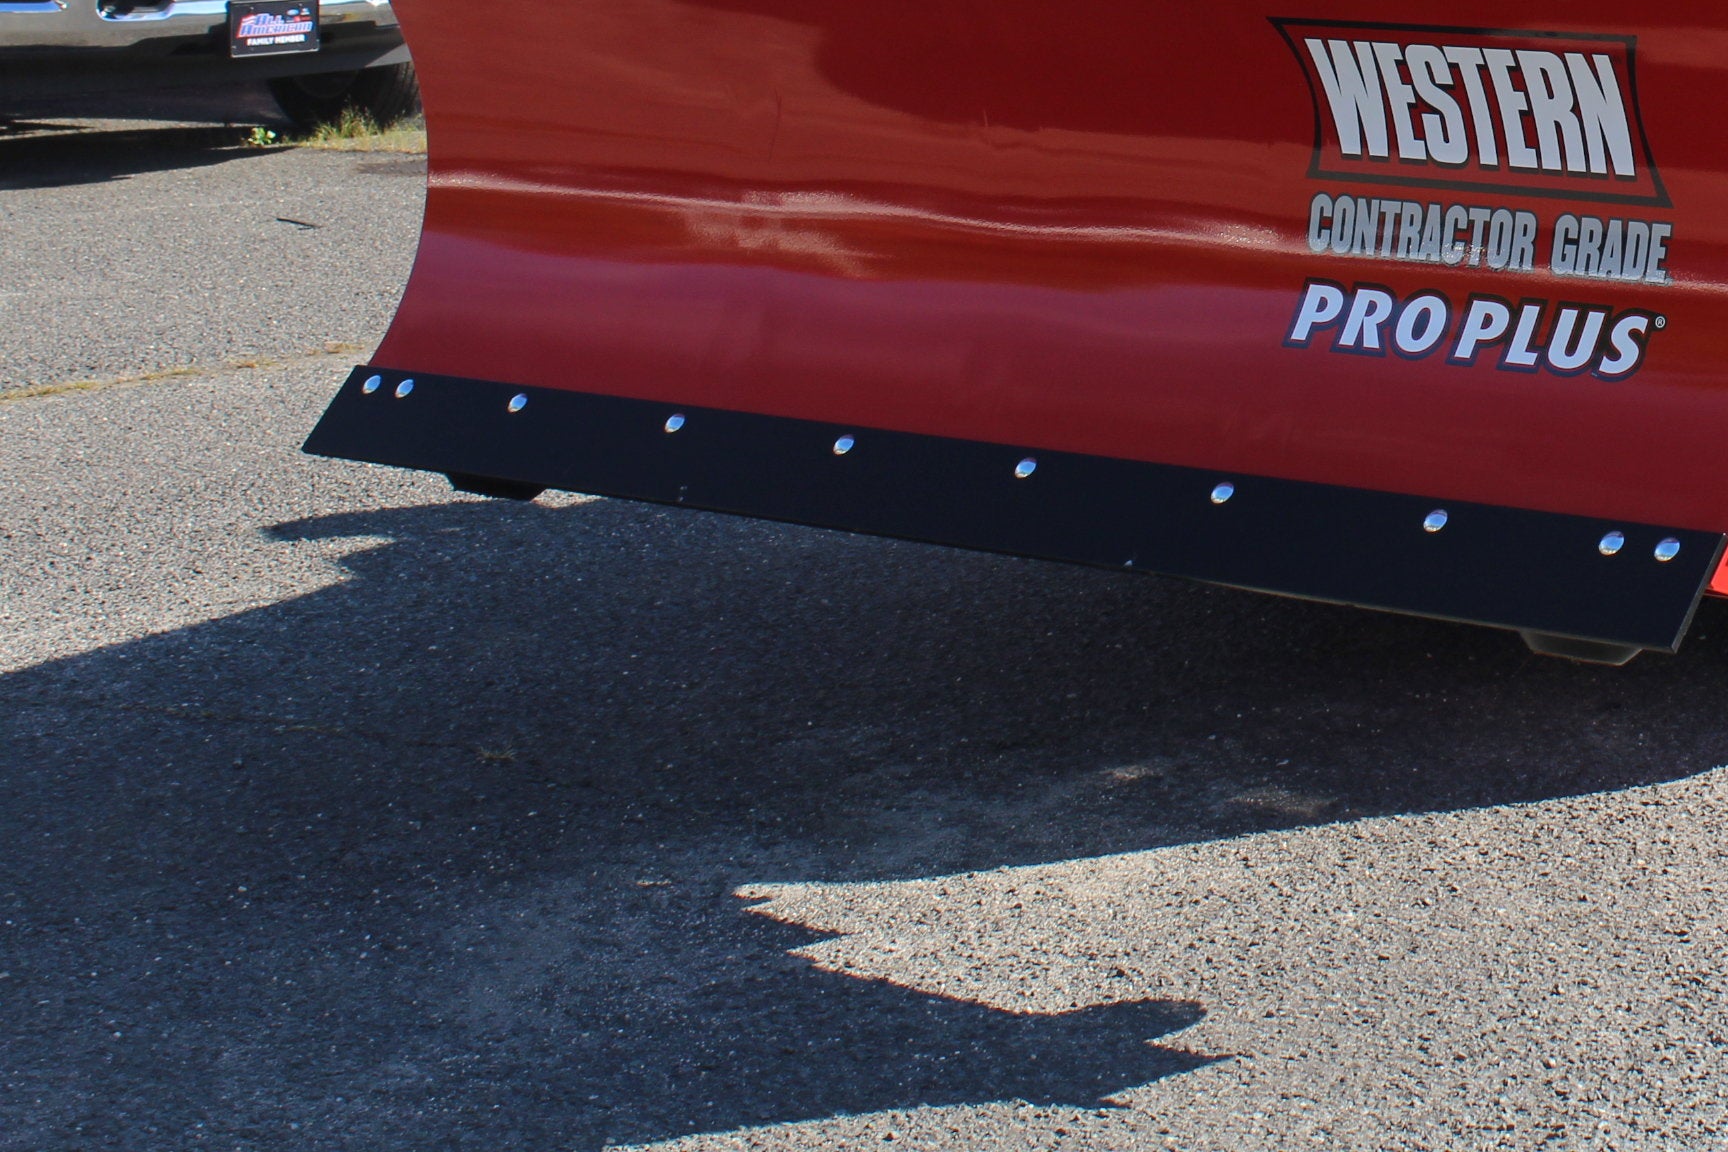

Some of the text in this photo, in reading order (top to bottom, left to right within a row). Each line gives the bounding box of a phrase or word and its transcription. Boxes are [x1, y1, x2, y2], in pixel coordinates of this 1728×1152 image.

[246, 34, 306, 47] FAMILY MEMBER
[1304, 37, 1637, 178] WESTERN
[1307, 192, 1674, 283] CONTRACTOR GRADE
